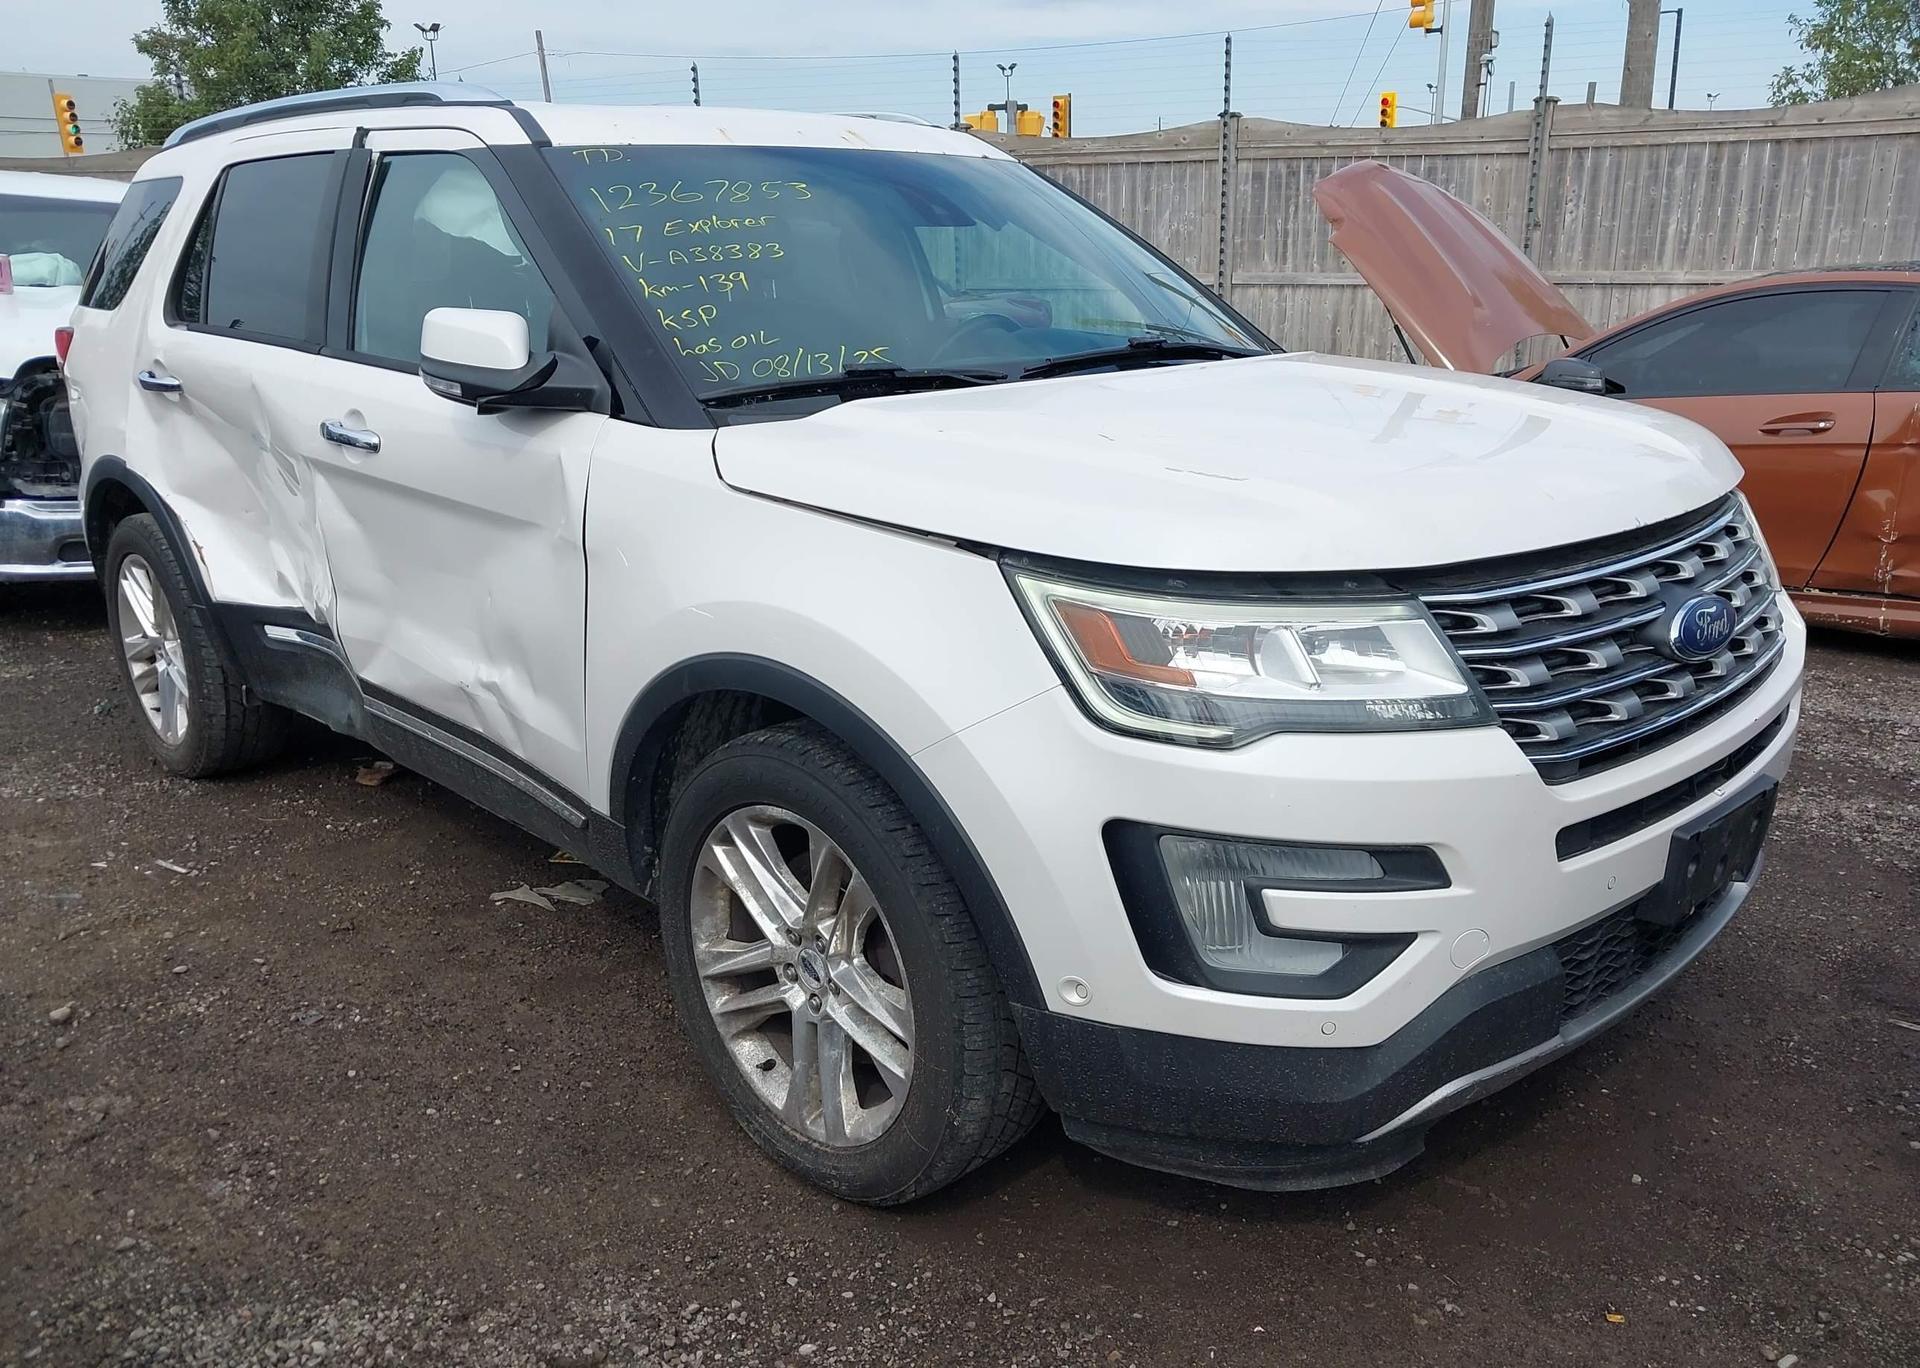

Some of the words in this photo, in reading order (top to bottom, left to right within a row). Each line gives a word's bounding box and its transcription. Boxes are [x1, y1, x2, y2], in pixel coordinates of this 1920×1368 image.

[589, 179, 812, 214] 12367853
[604, 225, 643, 246] 17
[663, 215, 776, 237] Explorer
[673, 336, 722, 358] has
[1695, 605, 1730, 646] Ford
